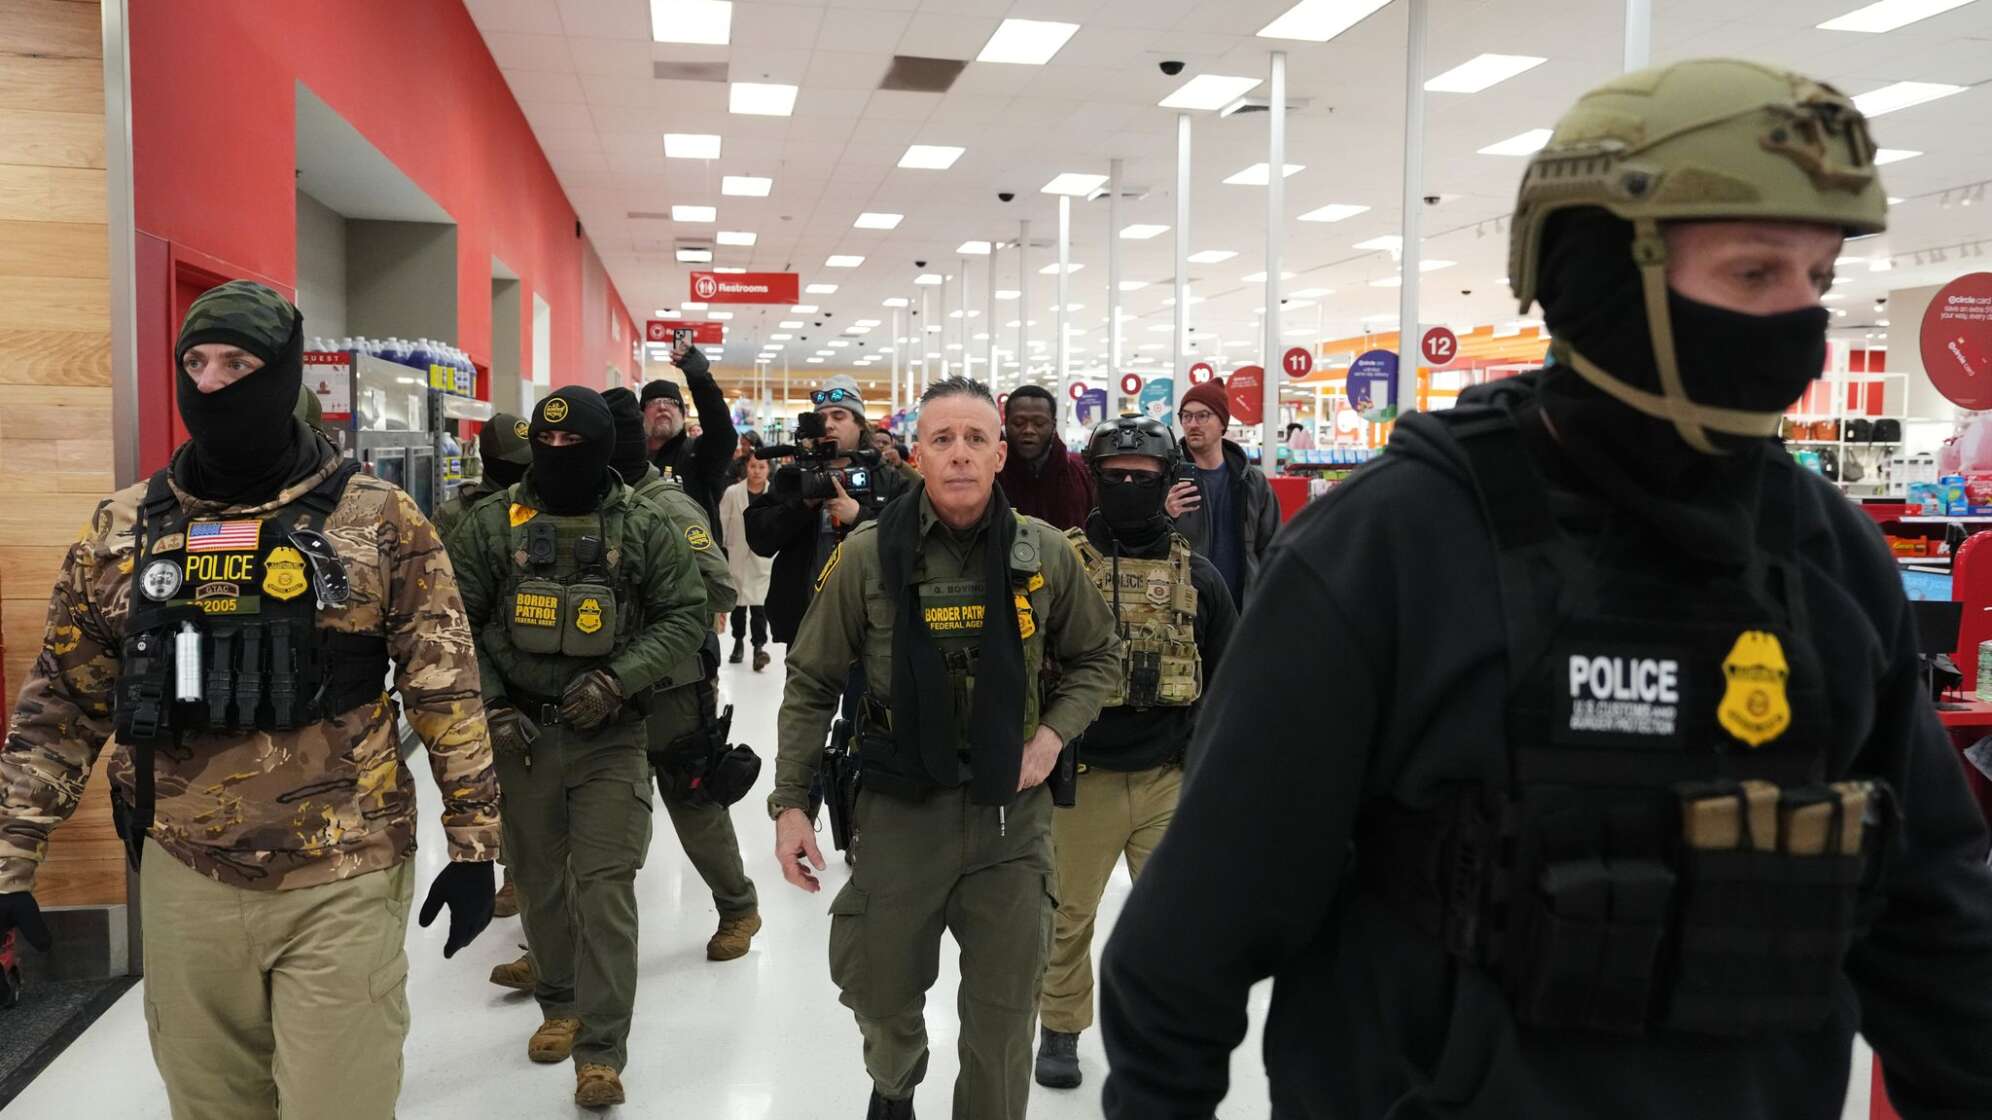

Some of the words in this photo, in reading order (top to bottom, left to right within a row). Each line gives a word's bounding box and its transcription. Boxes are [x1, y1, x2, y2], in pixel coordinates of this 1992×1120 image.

[718, 283, 769, 293] Restrooms
[1427, 337, 1451, 356] 12
[1289, 355, 1306, 371] 11
[1193, 367, 1210, 384] 10
[186, 555, 254, 581] POLICE
[1104, 572, 1144, 588] PLICE
[186, 600, 237, 612] 2005
[516, 593, 558, 609] BORDER
[515, 605, 557, 620] PATROL
[925, 606, 961, 622] BORDER
[930, 620, 965, 631] FEDERAL
[1568, 654, 1680, 704] POLICE
